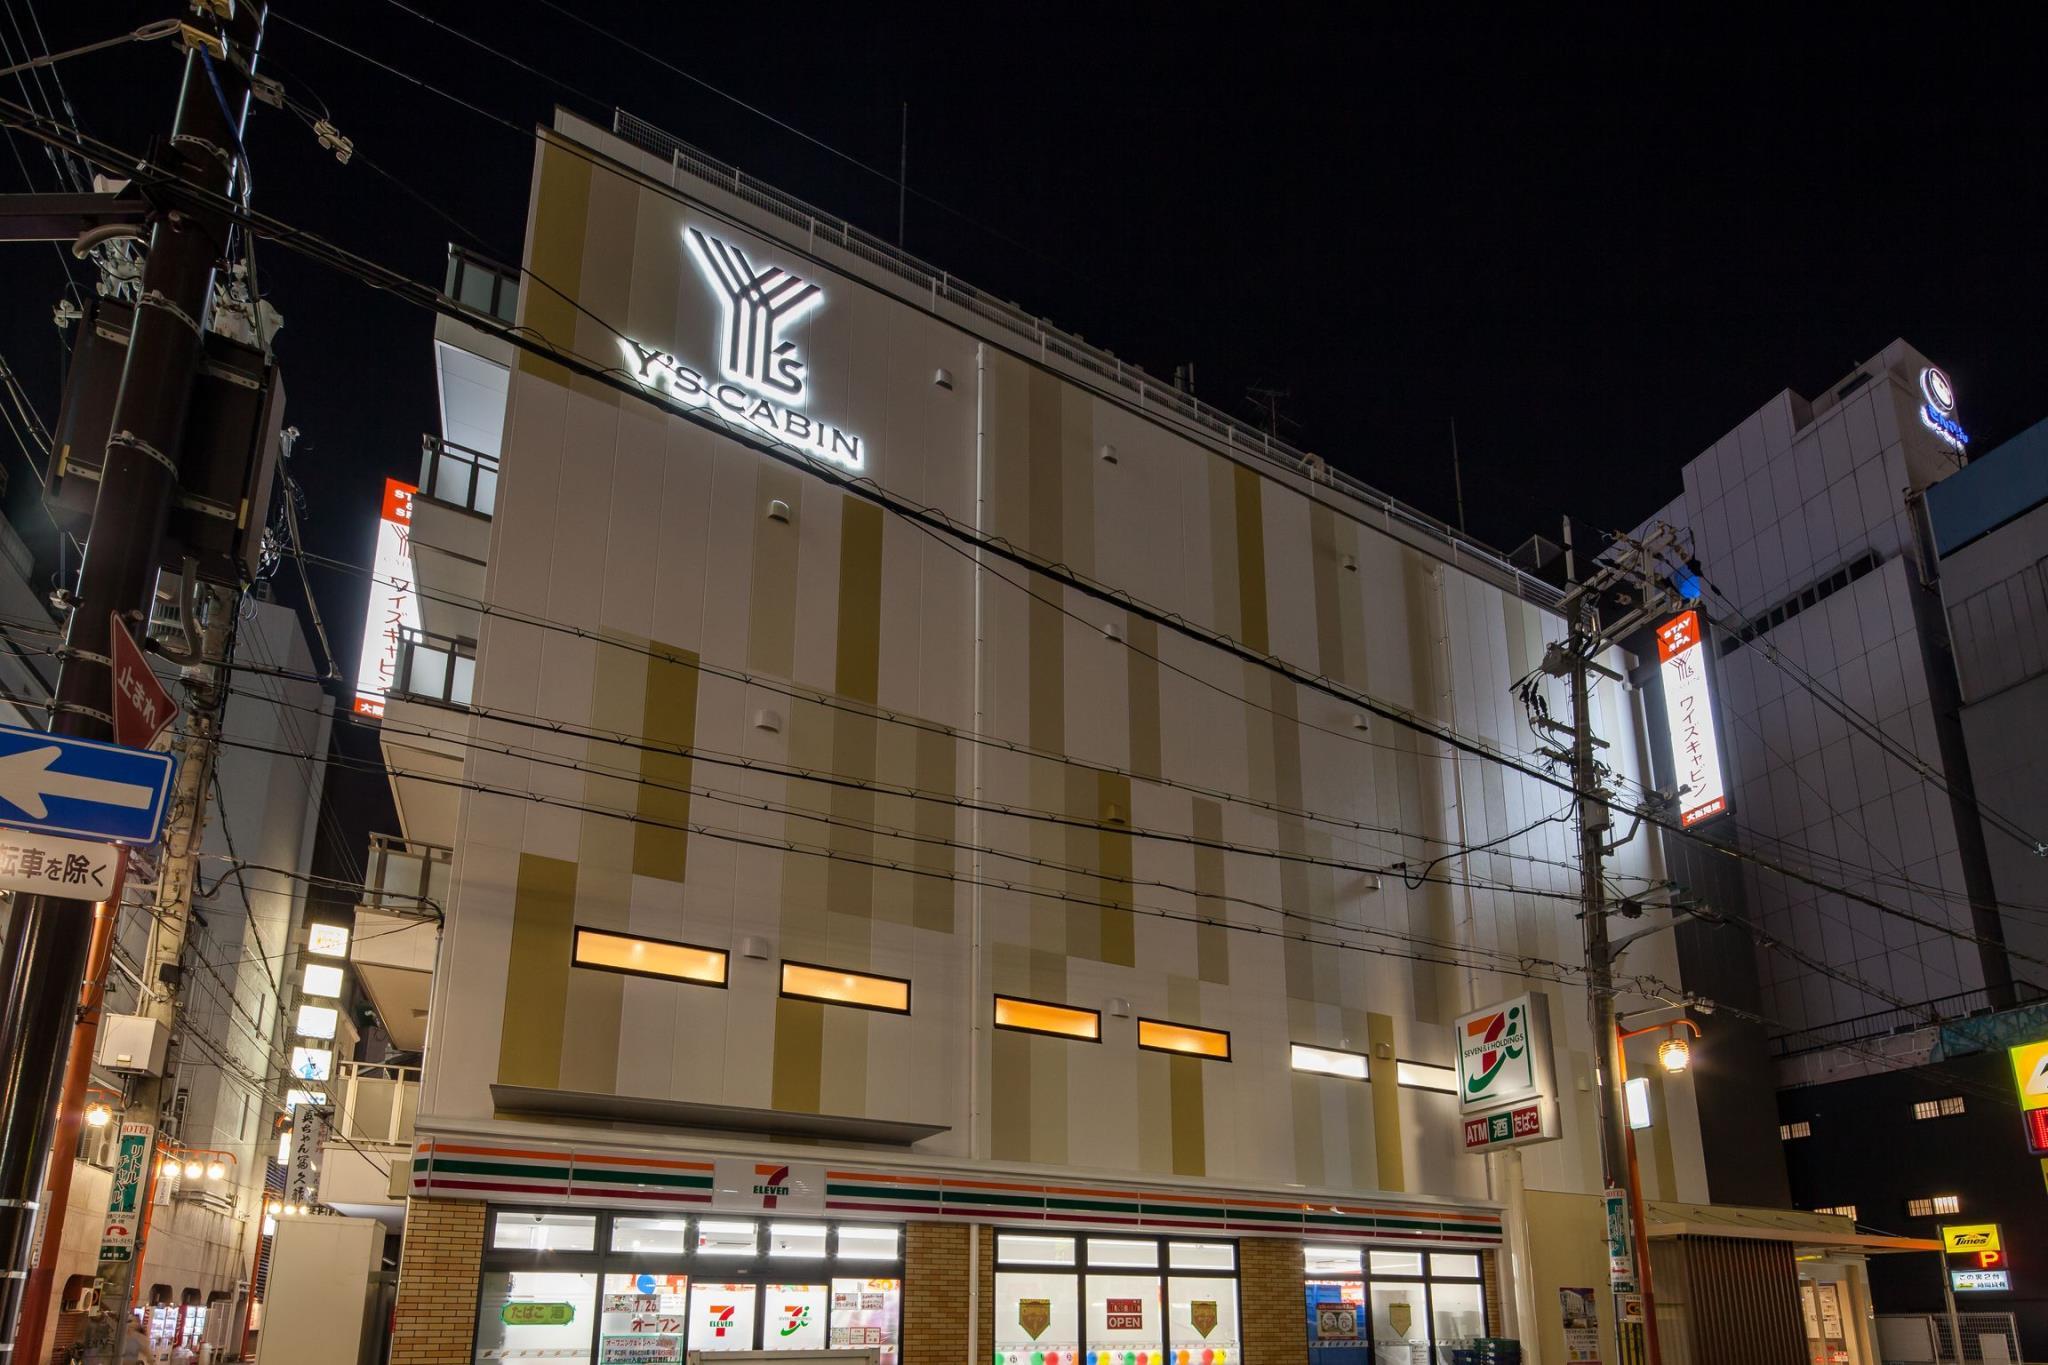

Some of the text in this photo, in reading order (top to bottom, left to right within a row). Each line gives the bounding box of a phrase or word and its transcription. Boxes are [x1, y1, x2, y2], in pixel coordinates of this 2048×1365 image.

[716, 384, 861, 461] CABIN
[1664, 617, 1691, 639] STAY
[1668, 635, 1691, 652] SPA
[117, 666, 157, 730] 止まれ
[1680, 695, 1707, 798] ワイズキャビン
[1491, 1034, 1525, 1049] HOLDINGS
[122, 1126, 152, 1135] HOTEL
[1466, 1111, 1539, 1144] ATM 酒 たばこ
[1954, 1233, 1991, 1246] Times
[1980, 1251, 1999, 1268] P
[511, 1306, 545, 1319] たばこ
[1108, 1317, 1141, 1328] OPEN
